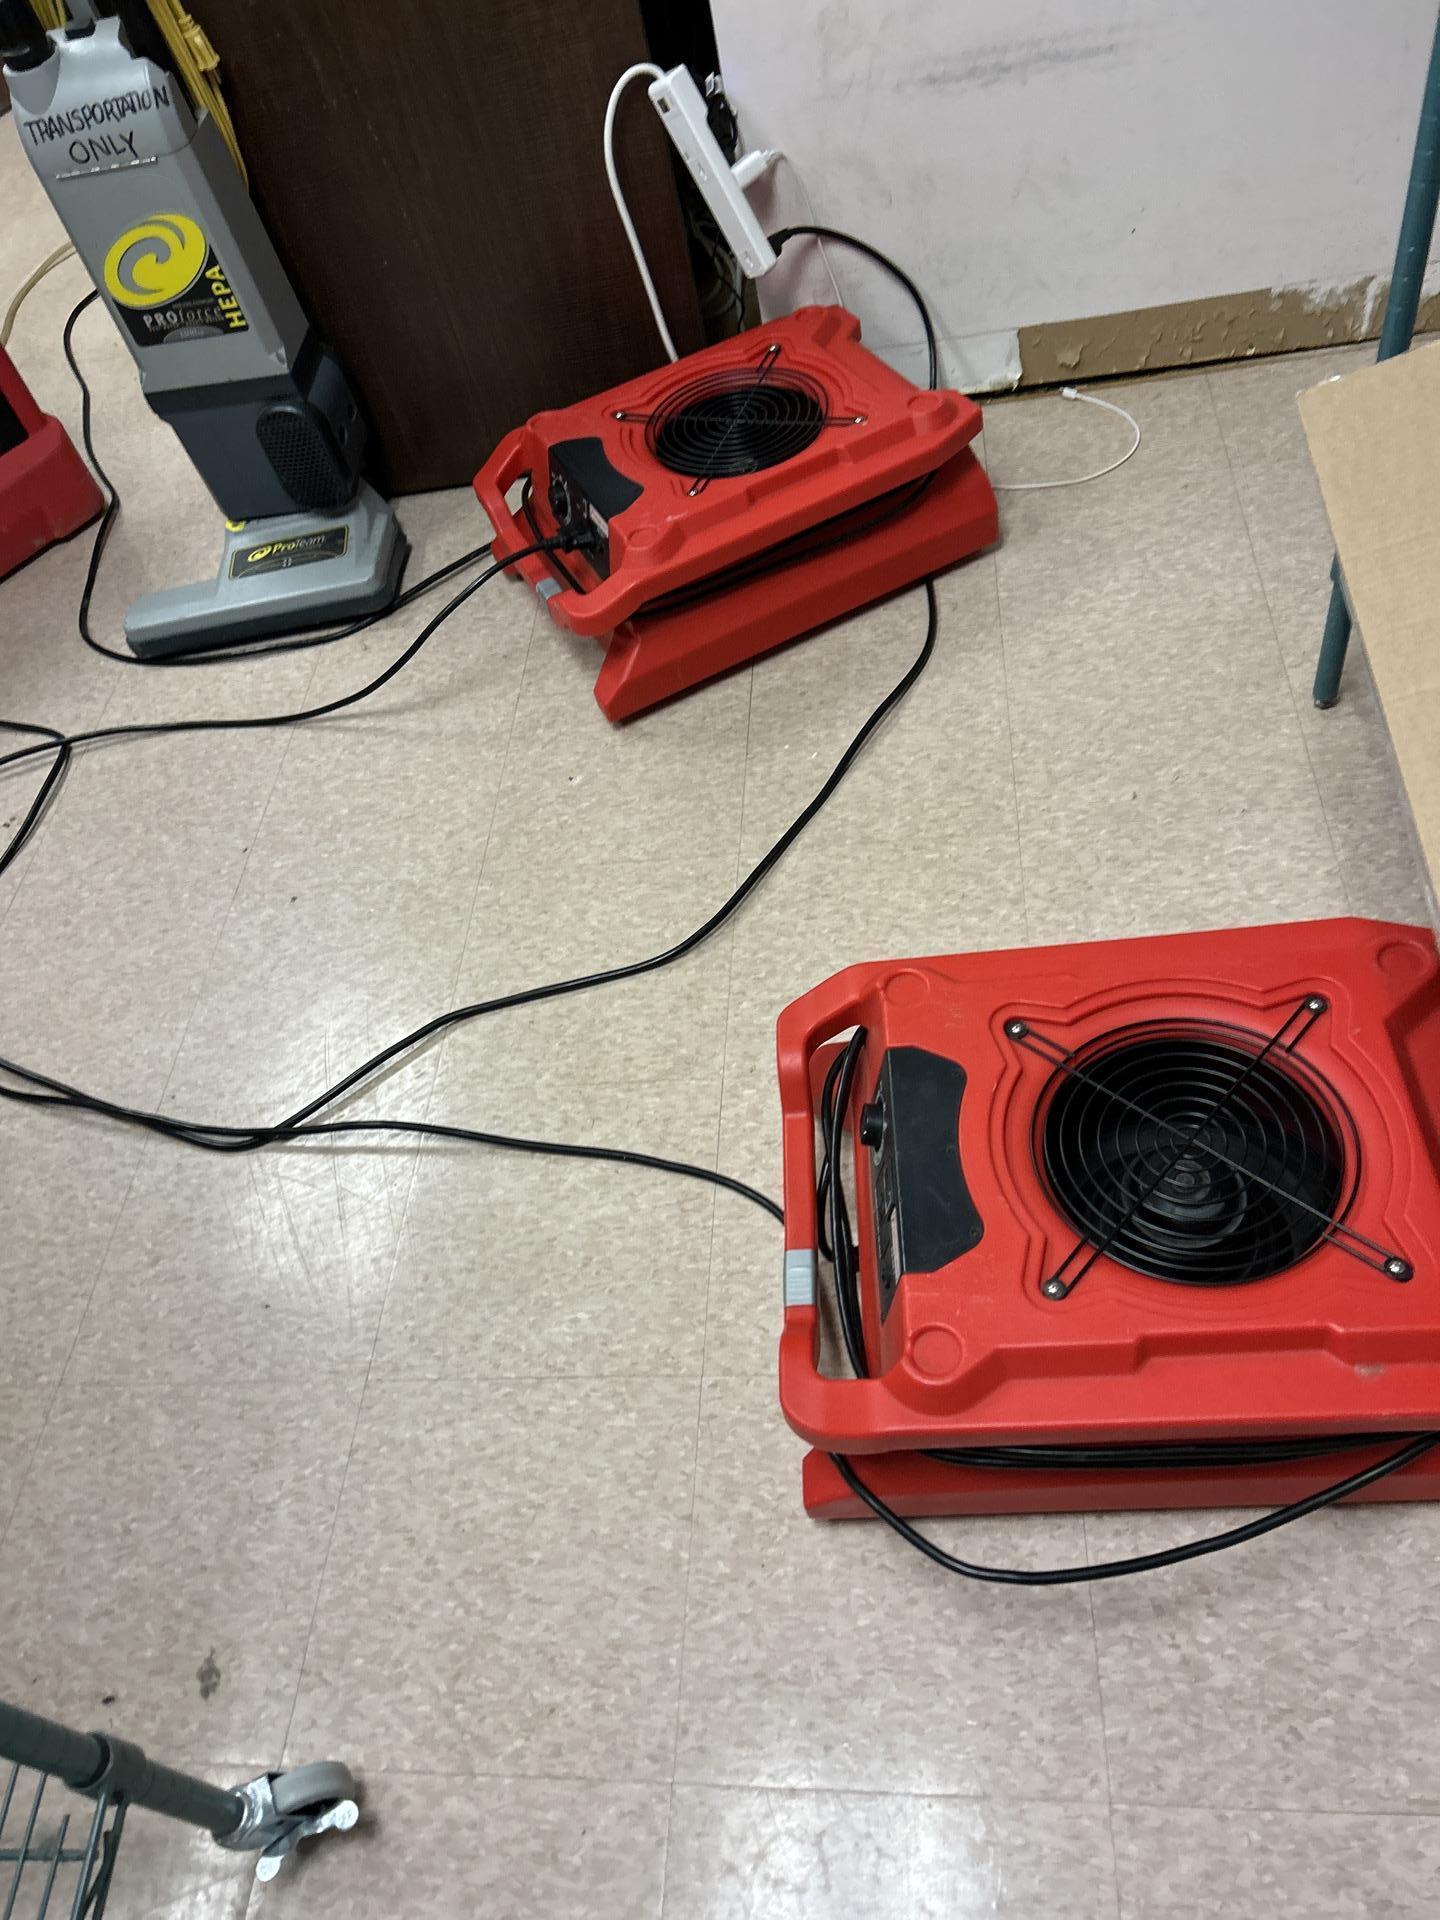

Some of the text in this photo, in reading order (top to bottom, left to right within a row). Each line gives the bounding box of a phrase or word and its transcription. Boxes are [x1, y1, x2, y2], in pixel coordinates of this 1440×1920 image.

[23, 85, 171, 146] TRANSPORTATION
[68, 130, 139, 165] ONLY
[204, 264, 247, 329] HEPA
